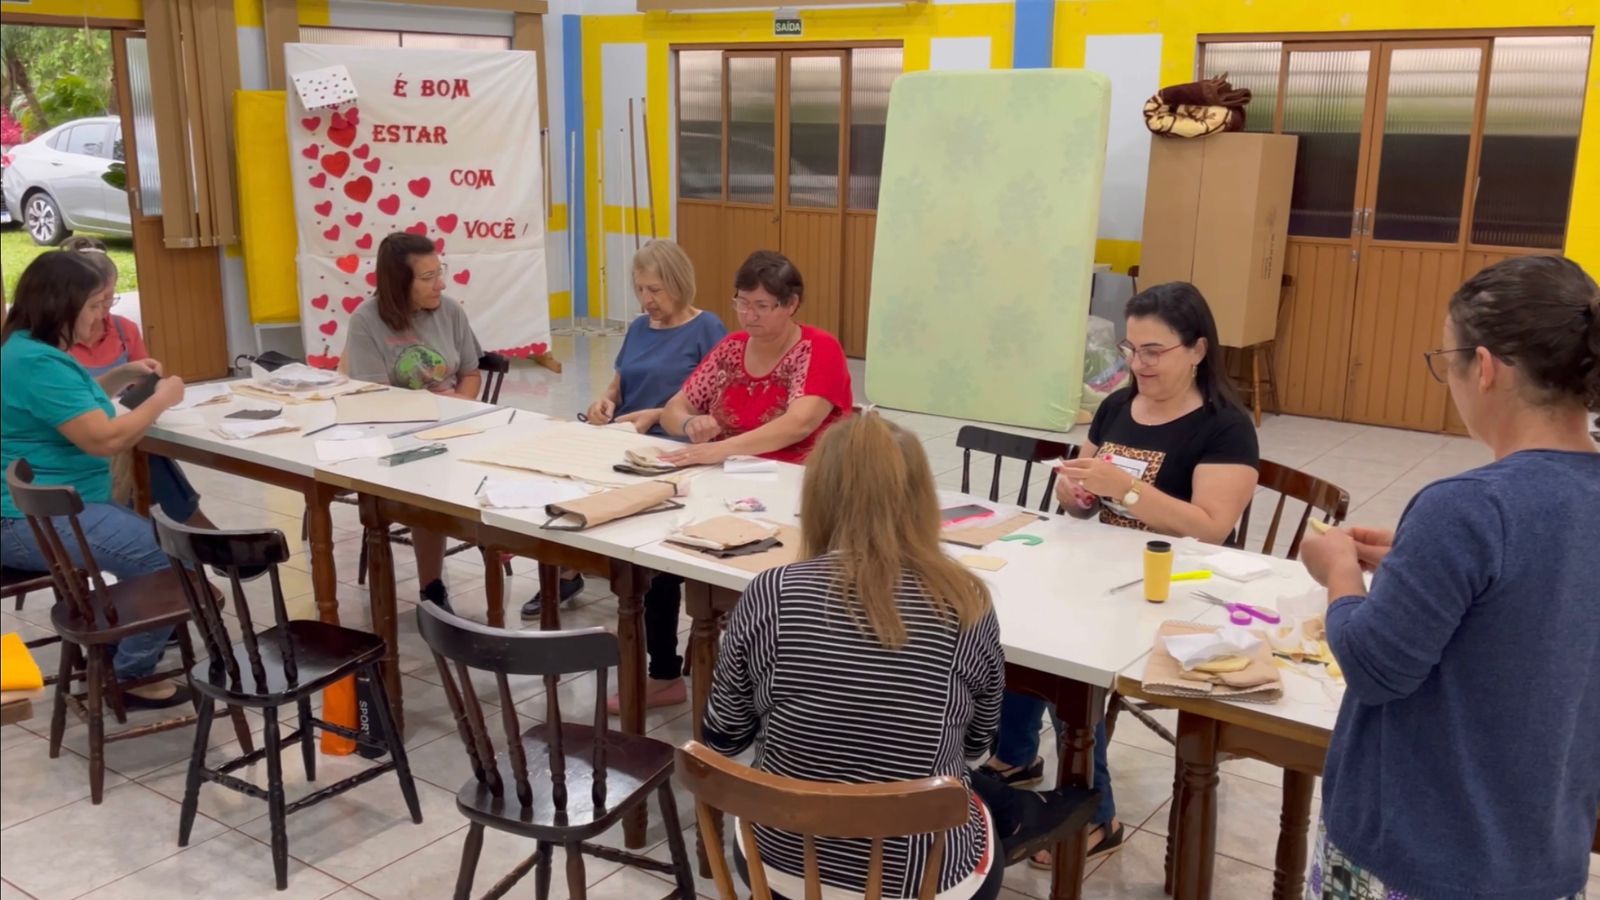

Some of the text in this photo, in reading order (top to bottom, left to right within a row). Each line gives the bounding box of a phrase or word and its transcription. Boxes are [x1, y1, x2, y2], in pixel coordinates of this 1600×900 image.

[393, 72, 470, 100] É BOM
[372, 124, 448, 144] ESTAR
[450, 169, 495, 189] COM
[463, 217, 516, 240] VOCÊ
